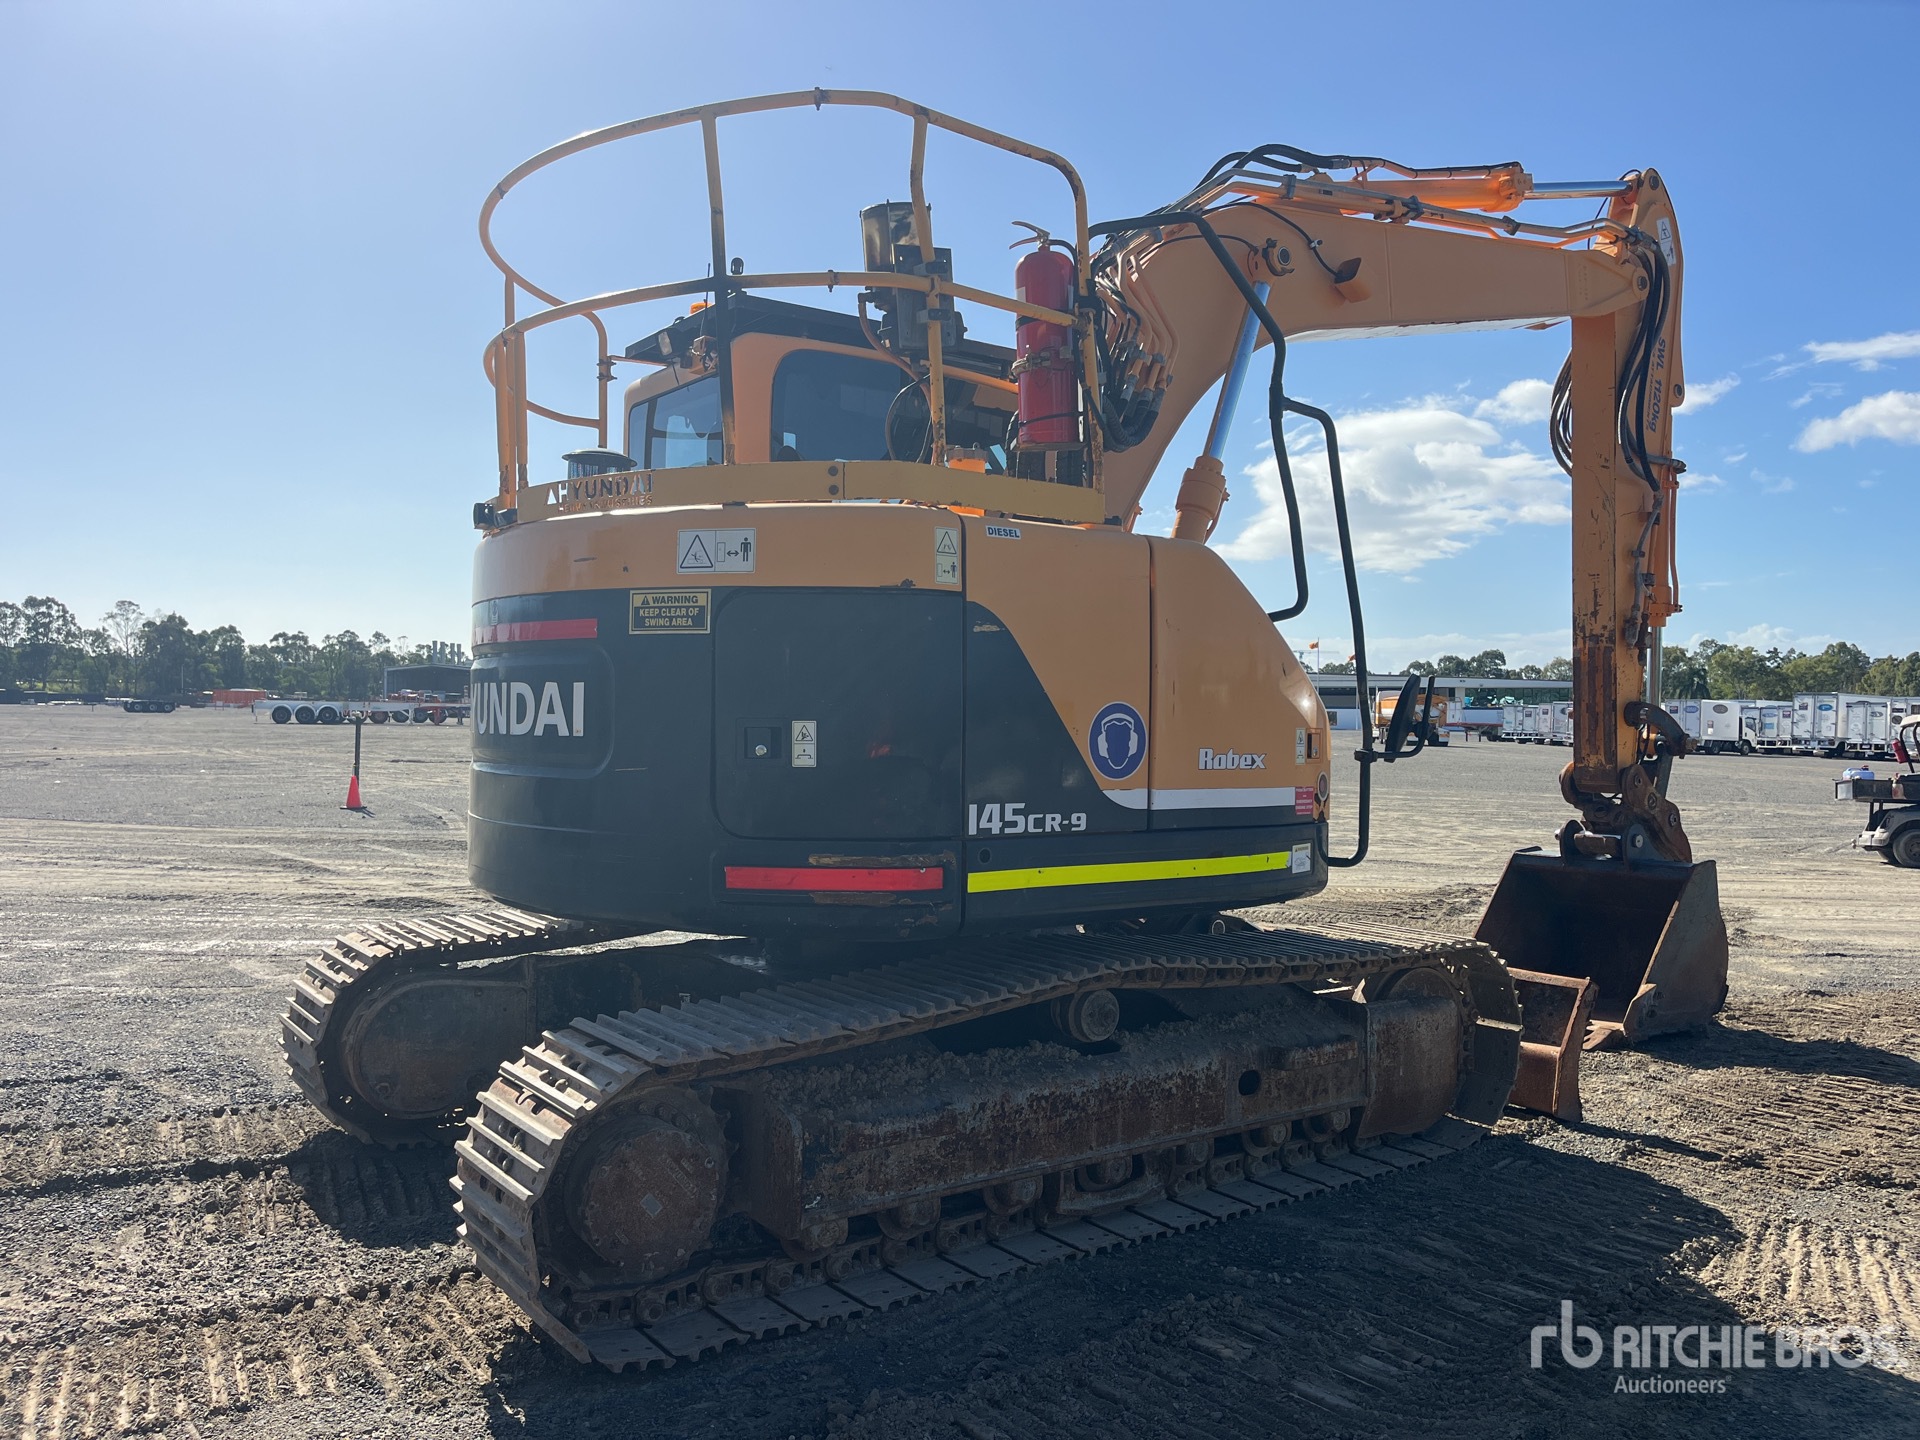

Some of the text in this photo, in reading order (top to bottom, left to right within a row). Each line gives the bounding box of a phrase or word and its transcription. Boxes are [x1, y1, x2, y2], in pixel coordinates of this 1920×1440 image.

[1649, 337, 1666, 433] SWL 1120kg
[558, 473, 653, 503] HYUNDAI
[987, 526, 1020, 538] DIESEL
[651, 595, 699, 604] WARNING
[639, 607, 700, 617] KEEP CLEAR OF
[644, 617, 693, 627] SWING AREA
[471, 682, 585, 737] YUNDAI
[1198, 748, 1266, 770] Robex
